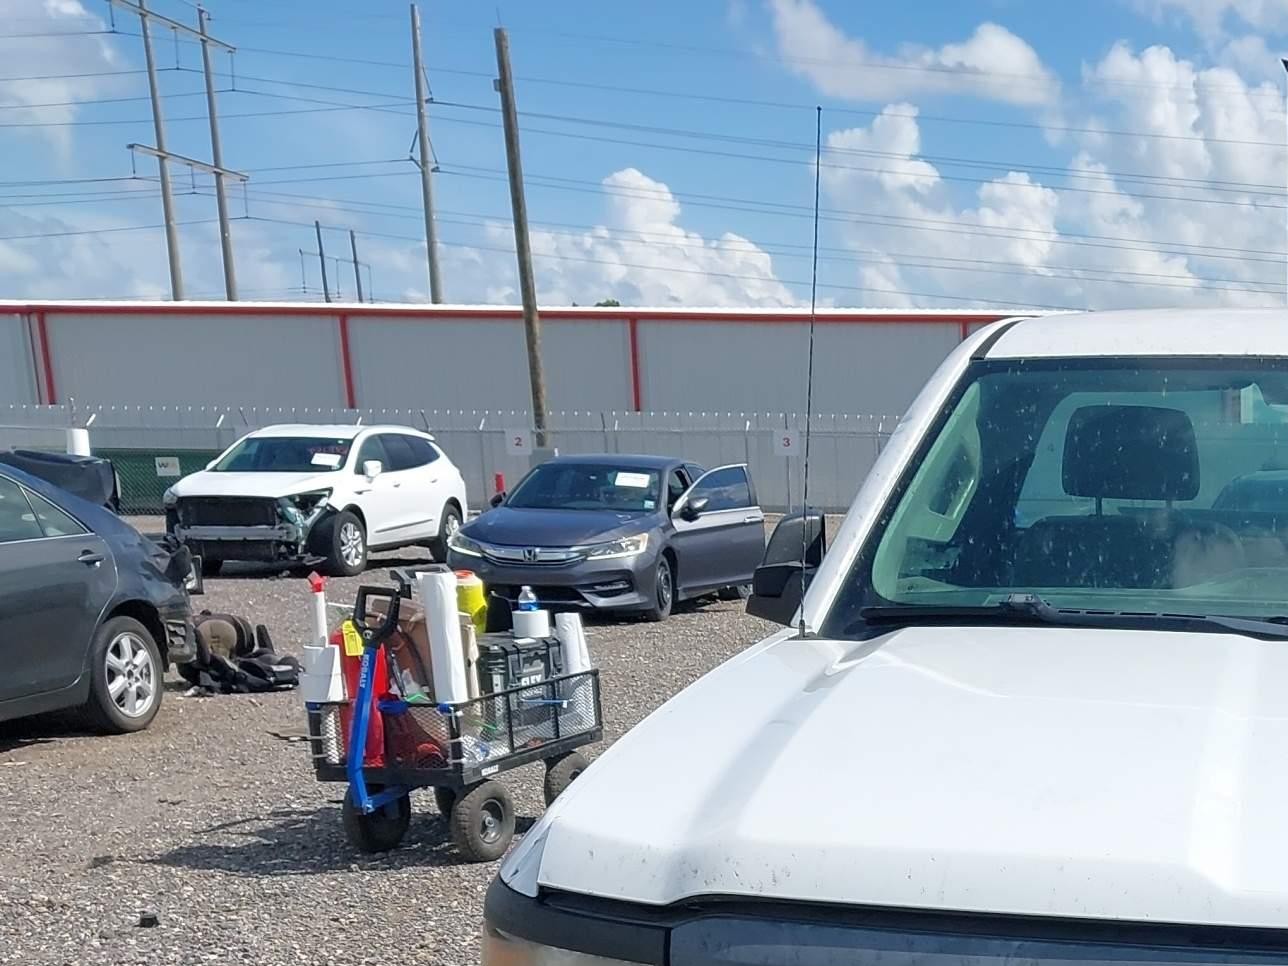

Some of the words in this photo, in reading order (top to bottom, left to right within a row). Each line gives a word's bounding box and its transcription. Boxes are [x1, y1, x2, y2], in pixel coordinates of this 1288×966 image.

[514, 436, 523, 447] 2
[782, 437, 791, 448] 3
[359, 654, 371, 688] KOBALT
